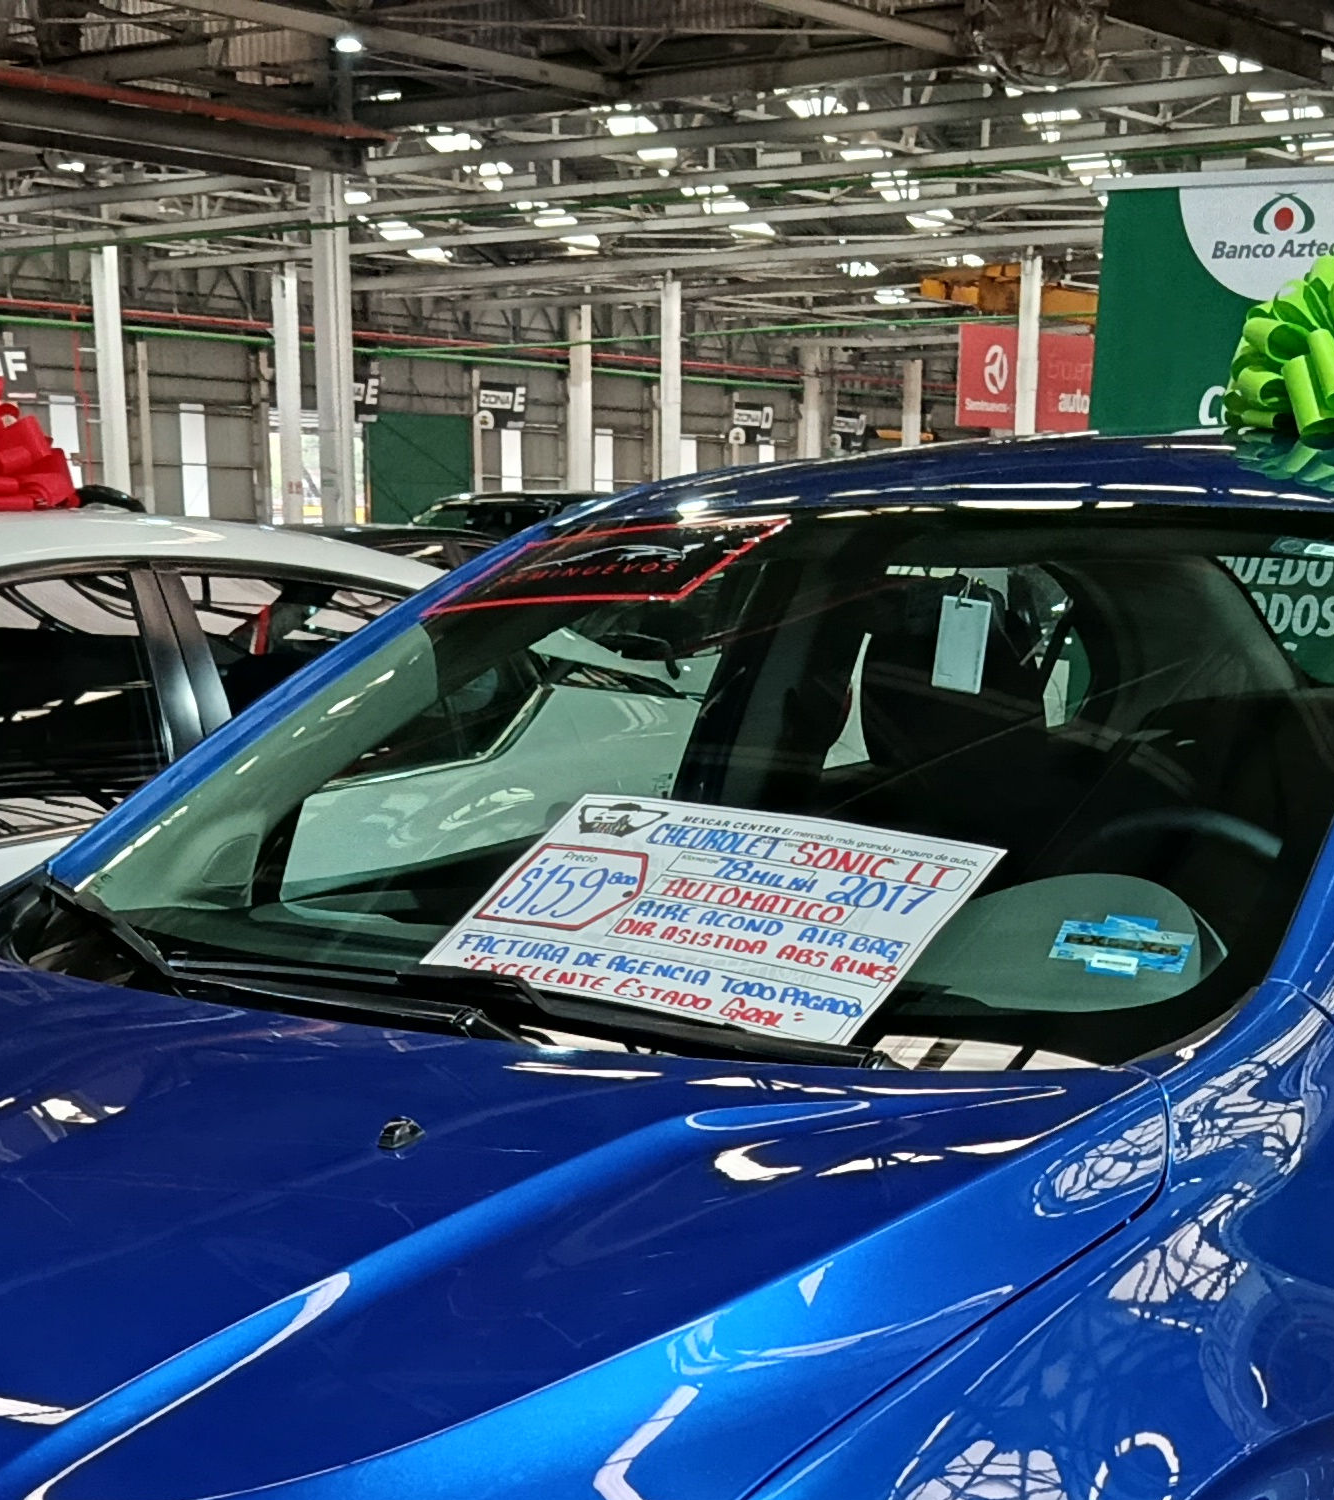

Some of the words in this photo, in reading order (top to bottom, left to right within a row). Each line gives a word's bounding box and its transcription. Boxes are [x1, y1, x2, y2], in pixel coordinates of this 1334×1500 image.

[1212, 241, 1275, 259] Banco
[3, 351, 28, 381] F
[512, 386, 527, 412] E
[761, 406, 773, 429] D
[683, 814, 730, 827] MEXCAR
[733, 822, 782, 834] CENTER
[783, 826, 793, 835] El
[793, 829, 834, 842] mercado
[857, 841, 891, 854] grande
[935, 853, 949, 861] de
[564, 850, 598, 863] Precio
[713, 857, 751, 879] 78
[751, 870, 785, 888] MIL
[790, 842, 894, 879] SONIC
[905, 861, 957, 888] LT
[660, 878, 846, 924] AUTOMATICO
[825, 876, 936, 915] 2017
[633, 900, 690, 923] AIRE
[698, 910, 784, 936] ACOND
[660, 927, 768, 955] ASISTIDA
[776, 944, 826, 968] ABS
[831, 955, 898, 983] RINES
[458, 932, 570, 964] FACTURA
[575, 952, 602, 968] DE
[607, 956, 711, 986] AGENCIA
[721, 975, 776, 1000] TODO
[780, 988, 863, 1018] PAGADO
[617, 977, 712, 1011] ESTADO
